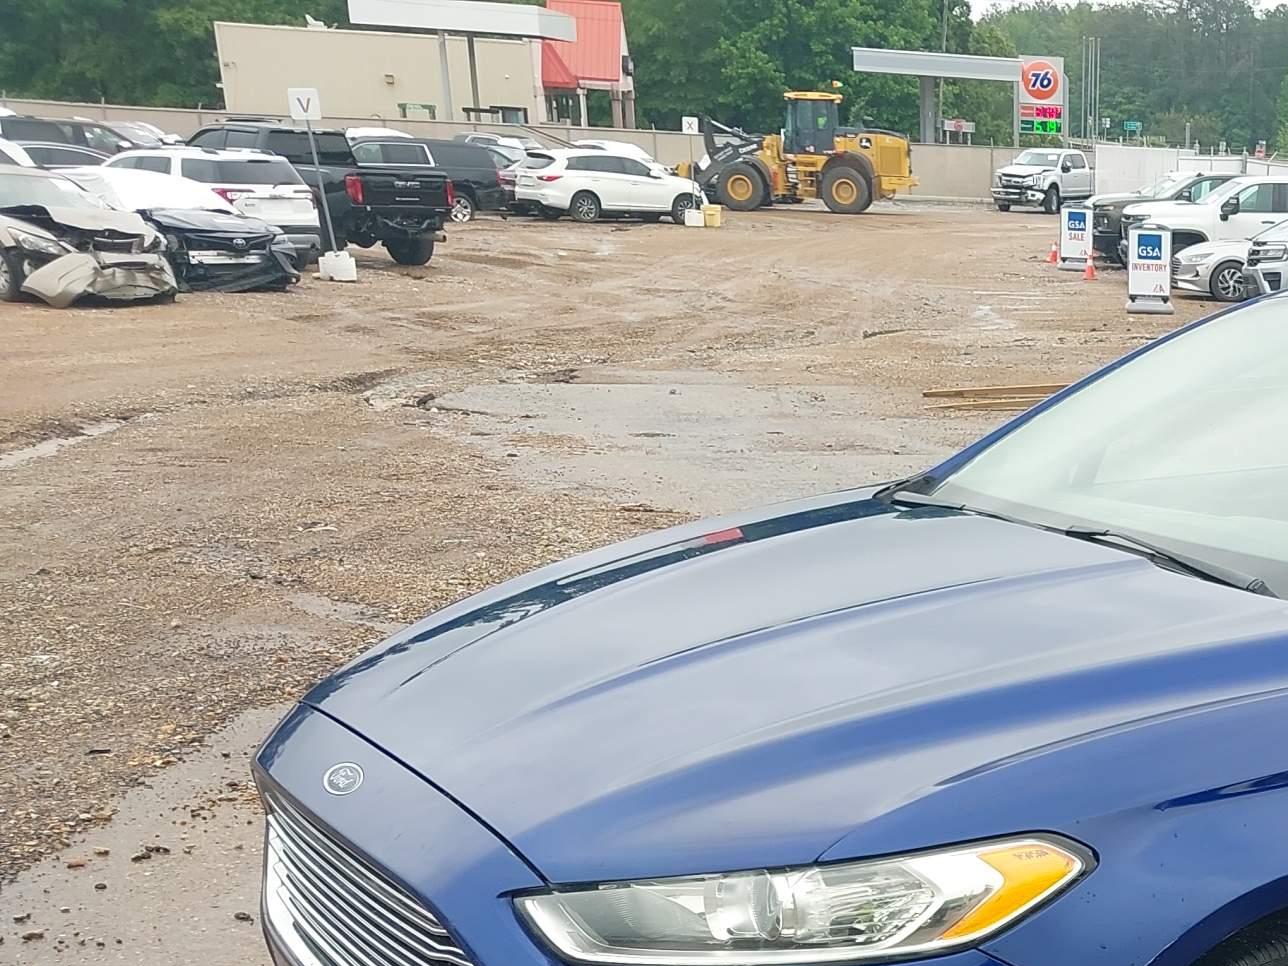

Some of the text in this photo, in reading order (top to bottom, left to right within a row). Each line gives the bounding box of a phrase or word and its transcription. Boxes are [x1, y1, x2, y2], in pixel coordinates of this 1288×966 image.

[1030, 70, 1052, 89] 76
[296, 97, 311, 113] V
[687, 120, 694, 130] X
[1068, 220, 1086, 229] GSA
[1068, 232, 1085, 241] SALE
[1138, 246, 1161, 257] GSA
[1131, 262, 1167, 272] INVENTORY
